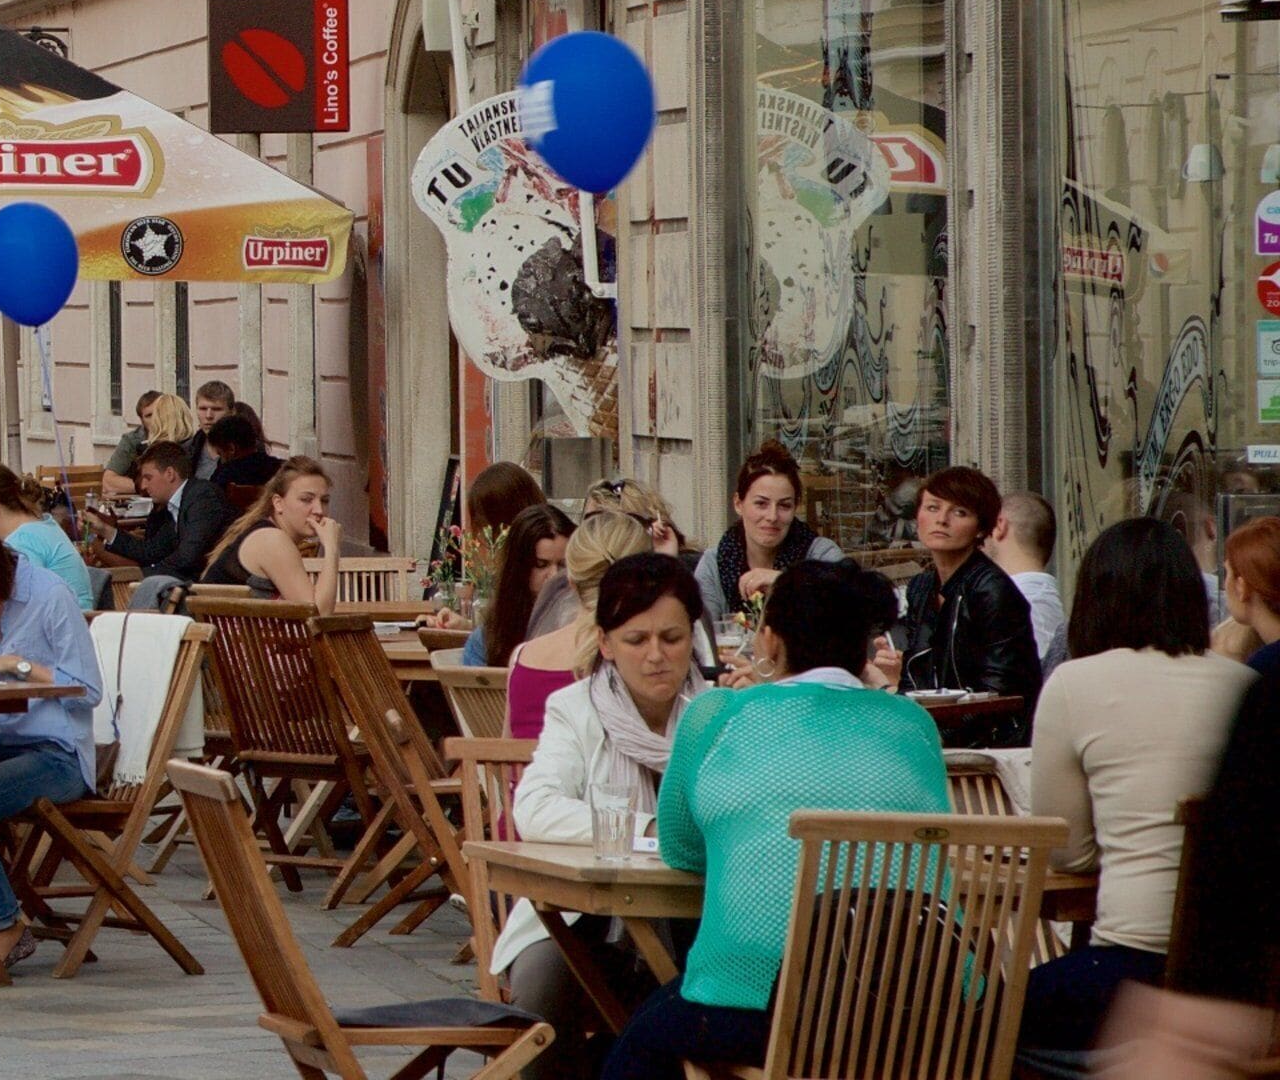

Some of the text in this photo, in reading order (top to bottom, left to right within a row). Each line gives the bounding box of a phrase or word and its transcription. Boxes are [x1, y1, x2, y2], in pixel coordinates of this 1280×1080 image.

[322, 6, 339, 124] Lino's Coffee
[427, 162, 473, 206] TU
[247, 236, 327, 267] Urpiner
